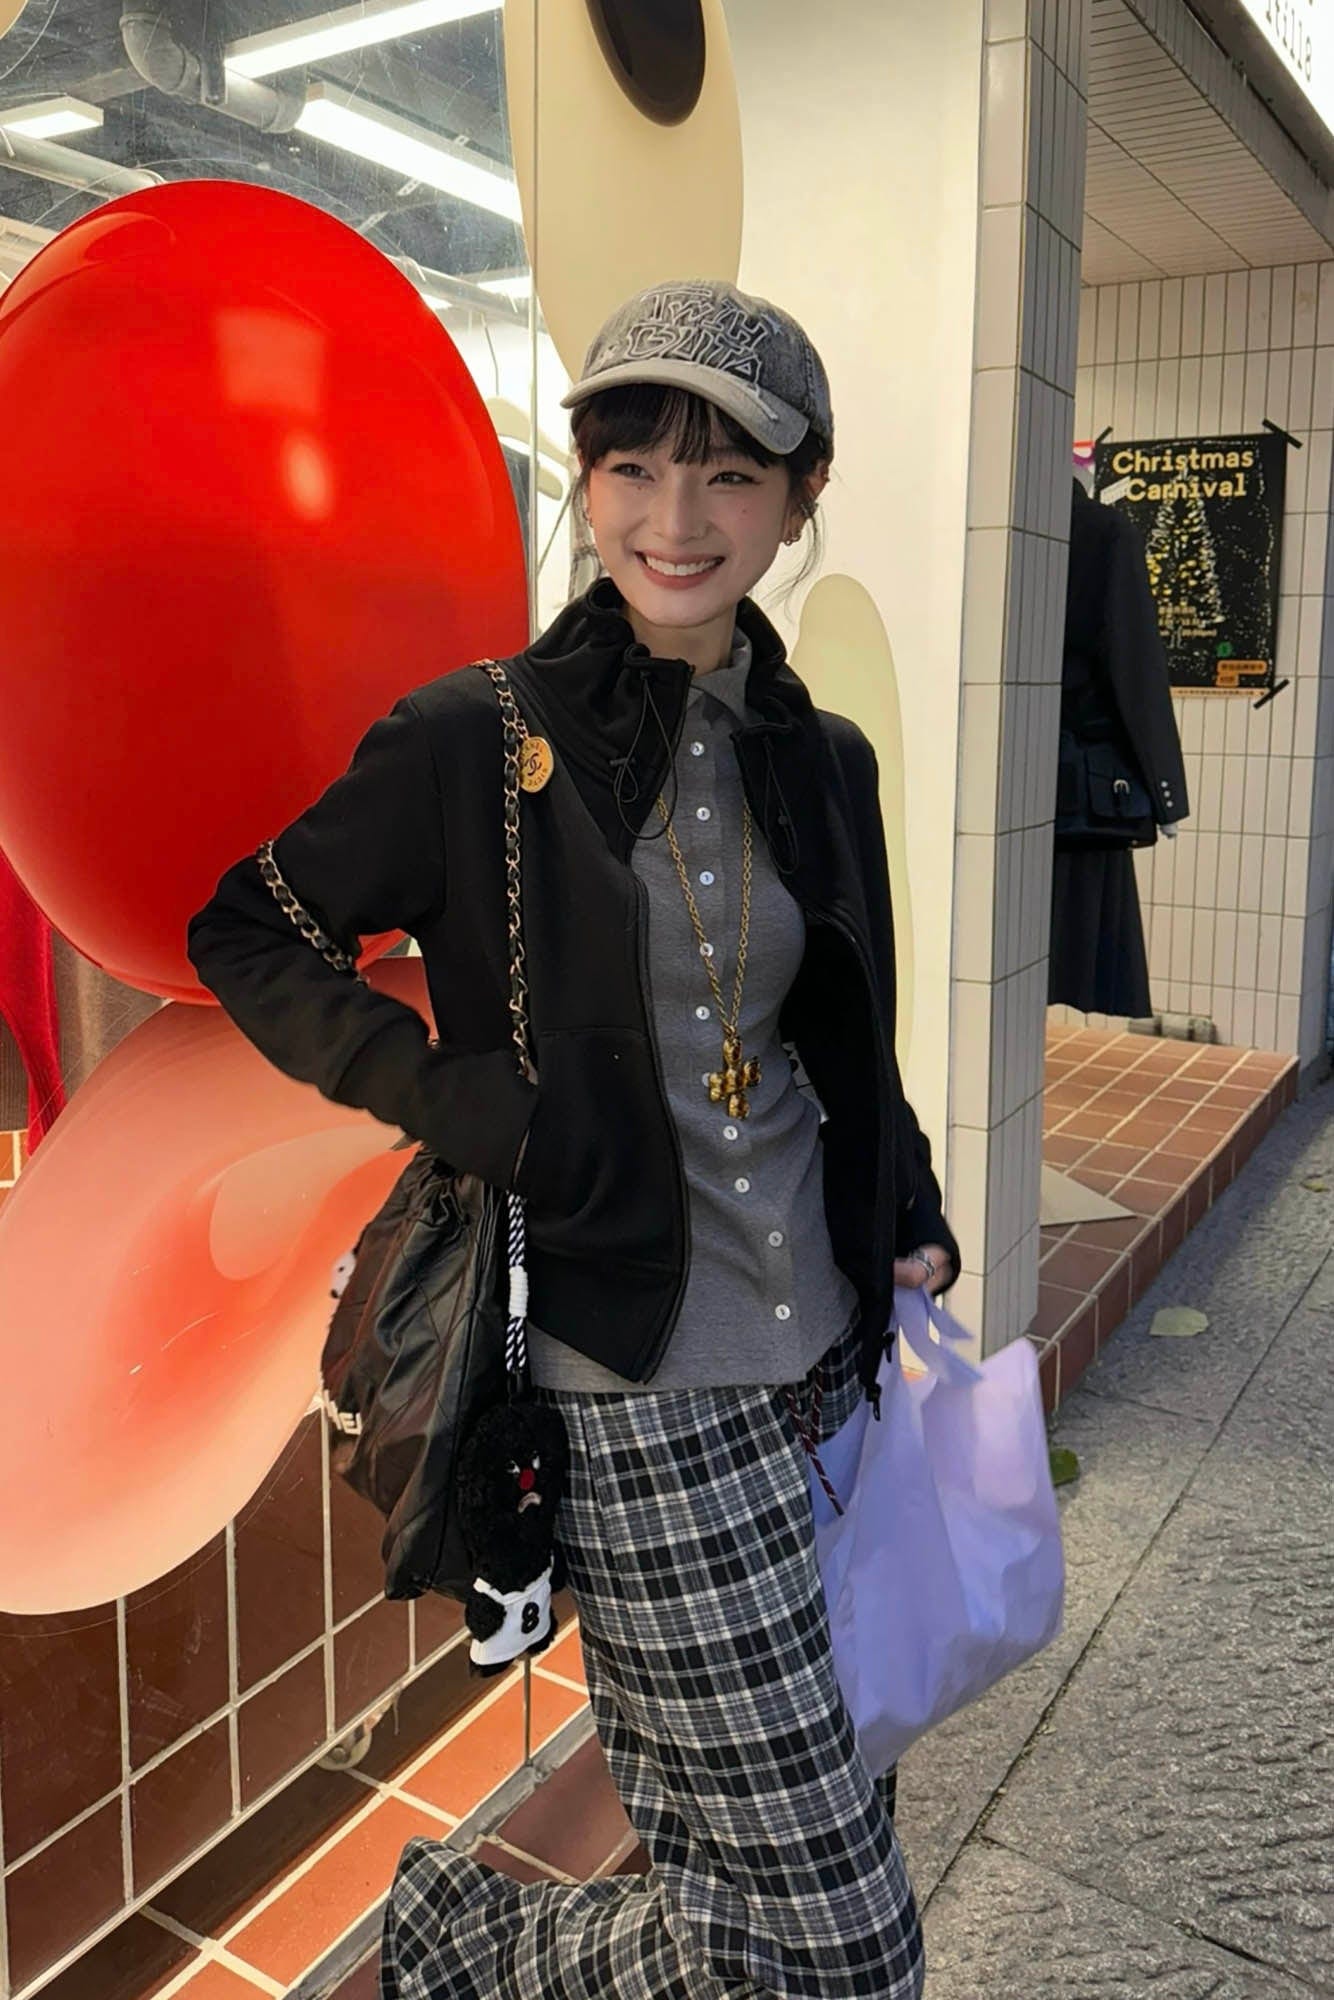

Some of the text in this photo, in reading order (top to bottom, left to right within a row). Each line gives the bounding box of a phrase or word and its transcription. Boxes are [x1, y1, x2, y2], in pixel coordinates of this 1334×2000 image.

[1113, 449, 1254, 474] Christmas
[1126, 473, 1247, 501] Carnival
[521, 1601, 540, 1634] 8
